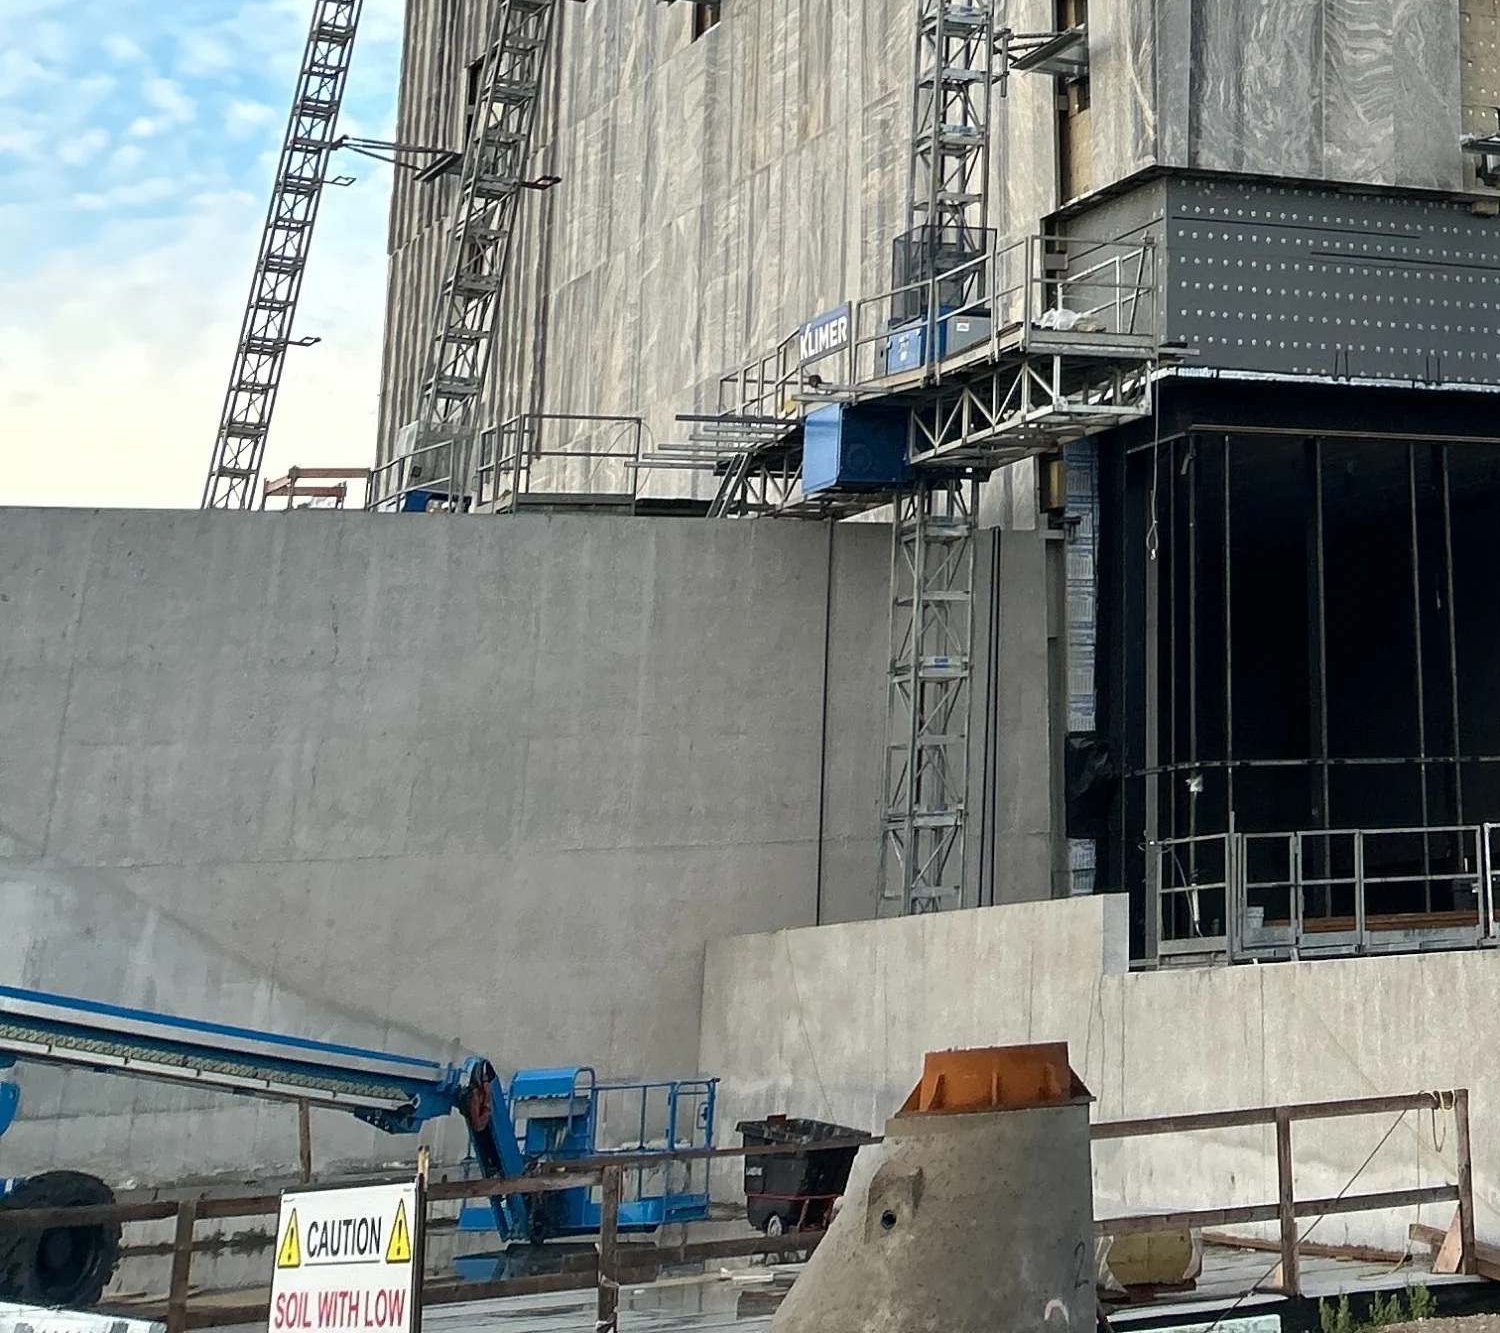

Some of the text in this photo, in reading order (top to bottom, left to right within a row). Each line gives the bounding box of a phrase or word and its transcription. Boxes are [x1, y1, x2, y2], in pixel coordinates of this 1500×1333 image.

[801, 316, 847, 360] KLIMER
[307, 1216, 381, 1258] CAUTION
[275, 1289, 406, 1329] SOIL WITH LOW
